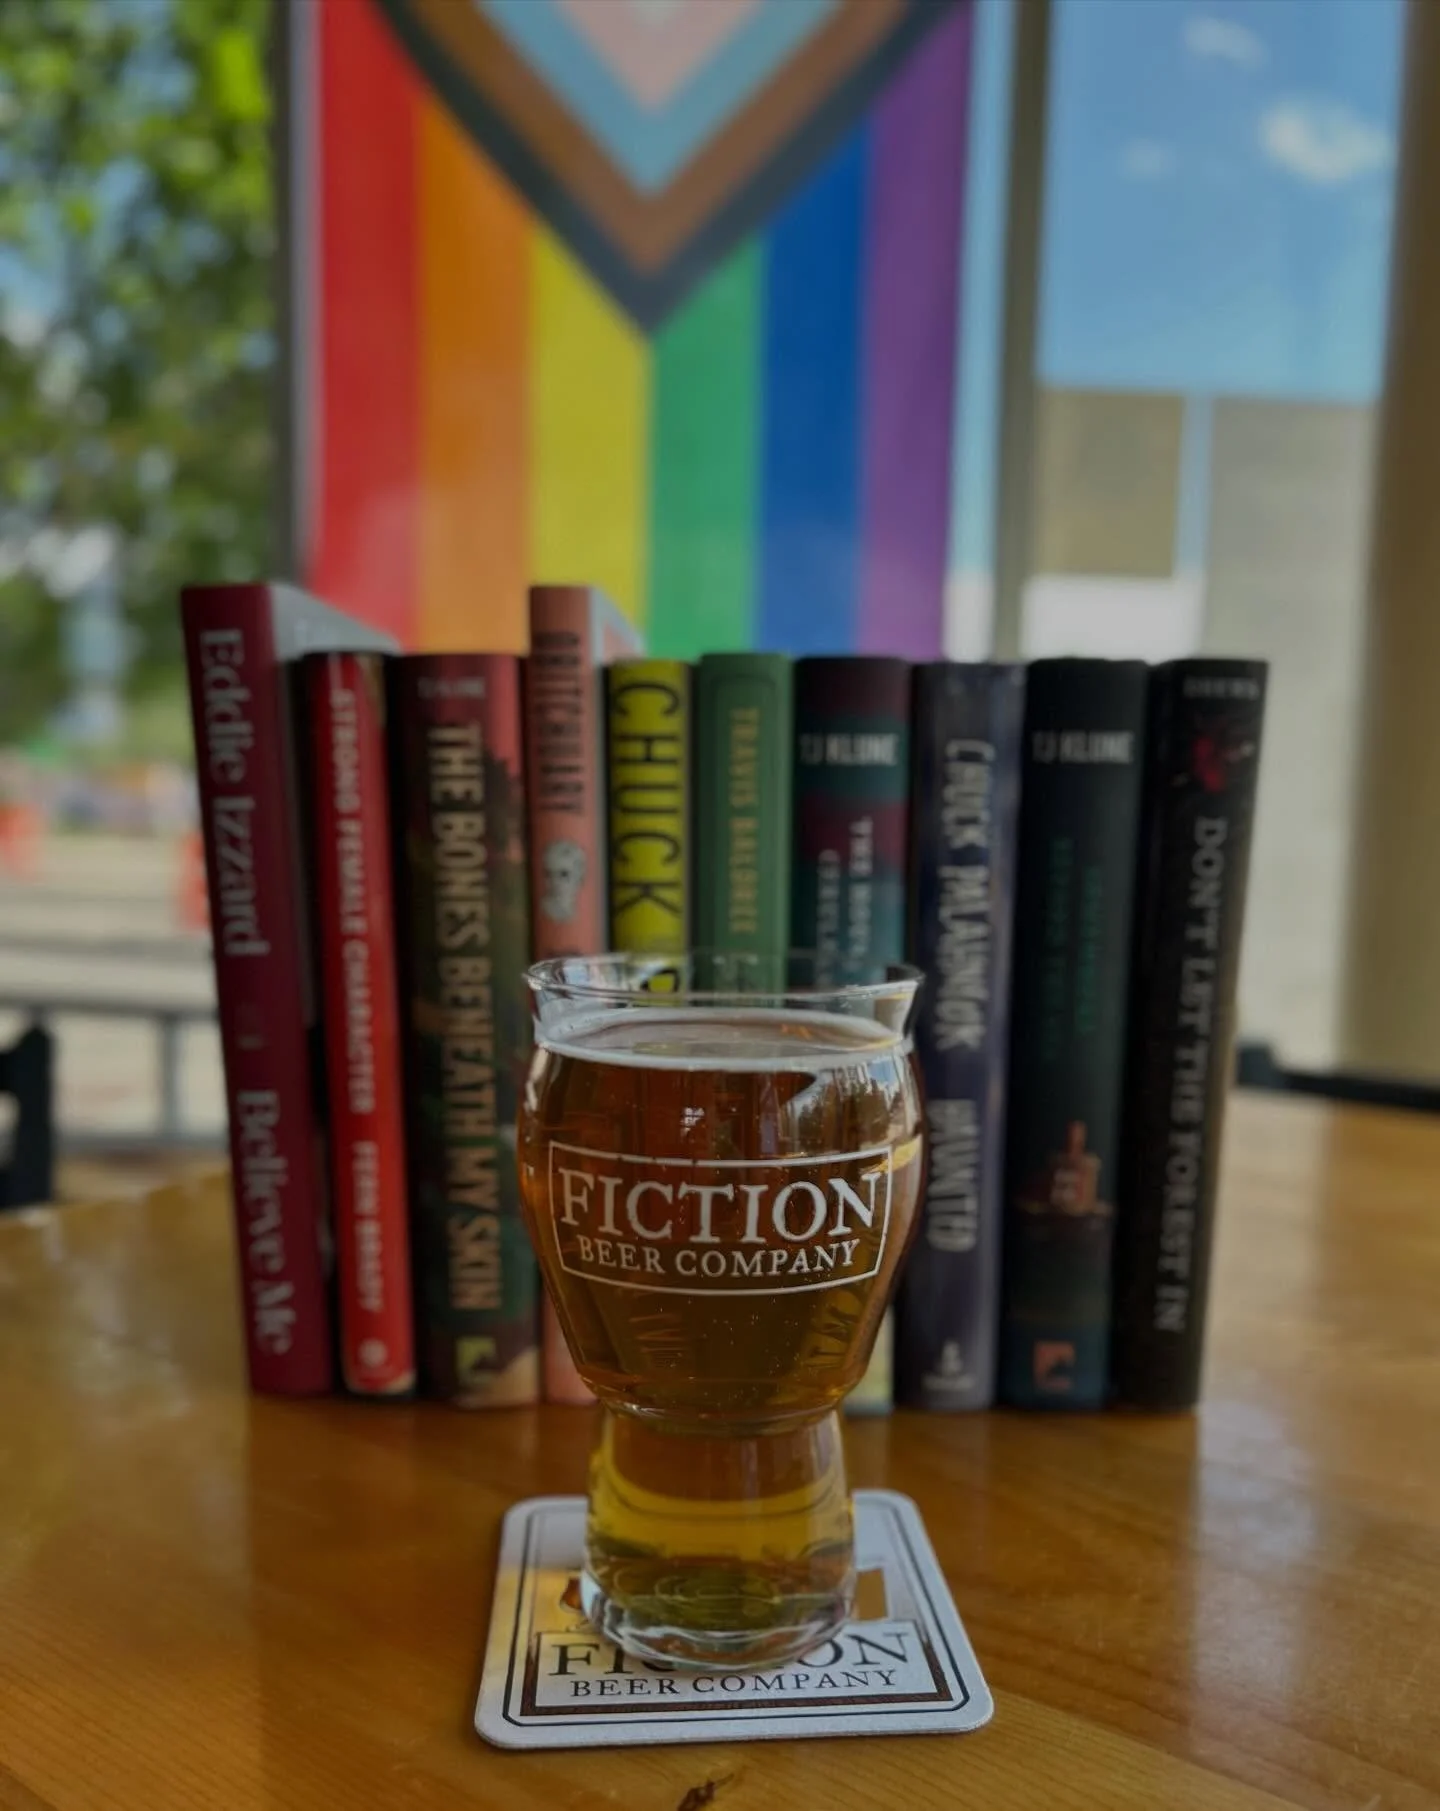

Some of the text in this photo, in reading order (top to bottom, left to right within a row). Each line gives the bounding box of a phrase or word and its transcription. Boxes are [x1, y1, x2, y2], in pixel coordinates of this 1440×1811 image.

[198, 627, 255, 783] Eddie
[426, 722, 486, 805] THE
[613, 682, 681, 919] CHUCK
[730, 706, 760, 809] TRAVIS
[944, 739, 997, 850] CHUCK
[211, 794, 271, 957] Izzard
[336, 818, 369, 937] FEMALE
[431, 811, 491, 948] BONES
[1177, 955, 1217, 1035] LET
[437, 956, 498, 1137] BENEATH
[1169, 1040, 1210, 1123] THE
[236, 1089, 289, 1273] Believe
[445, 1146, 501, 1209] MY
[558, 1167, 880, 1244] FICTION
[1157, 1130, 1202, 1278] FOREST
[446, 1215, 503, 1310] SKIN
[576, 1234, 860, 1278] BEER COMPANY
[250, 1279, 297, 1356] Me
[1153, 1284, 1188, 1333] IN
[548, 1632, 910, 1676] FION
[570, 1669, 897, 1697] BEER COMPANY
